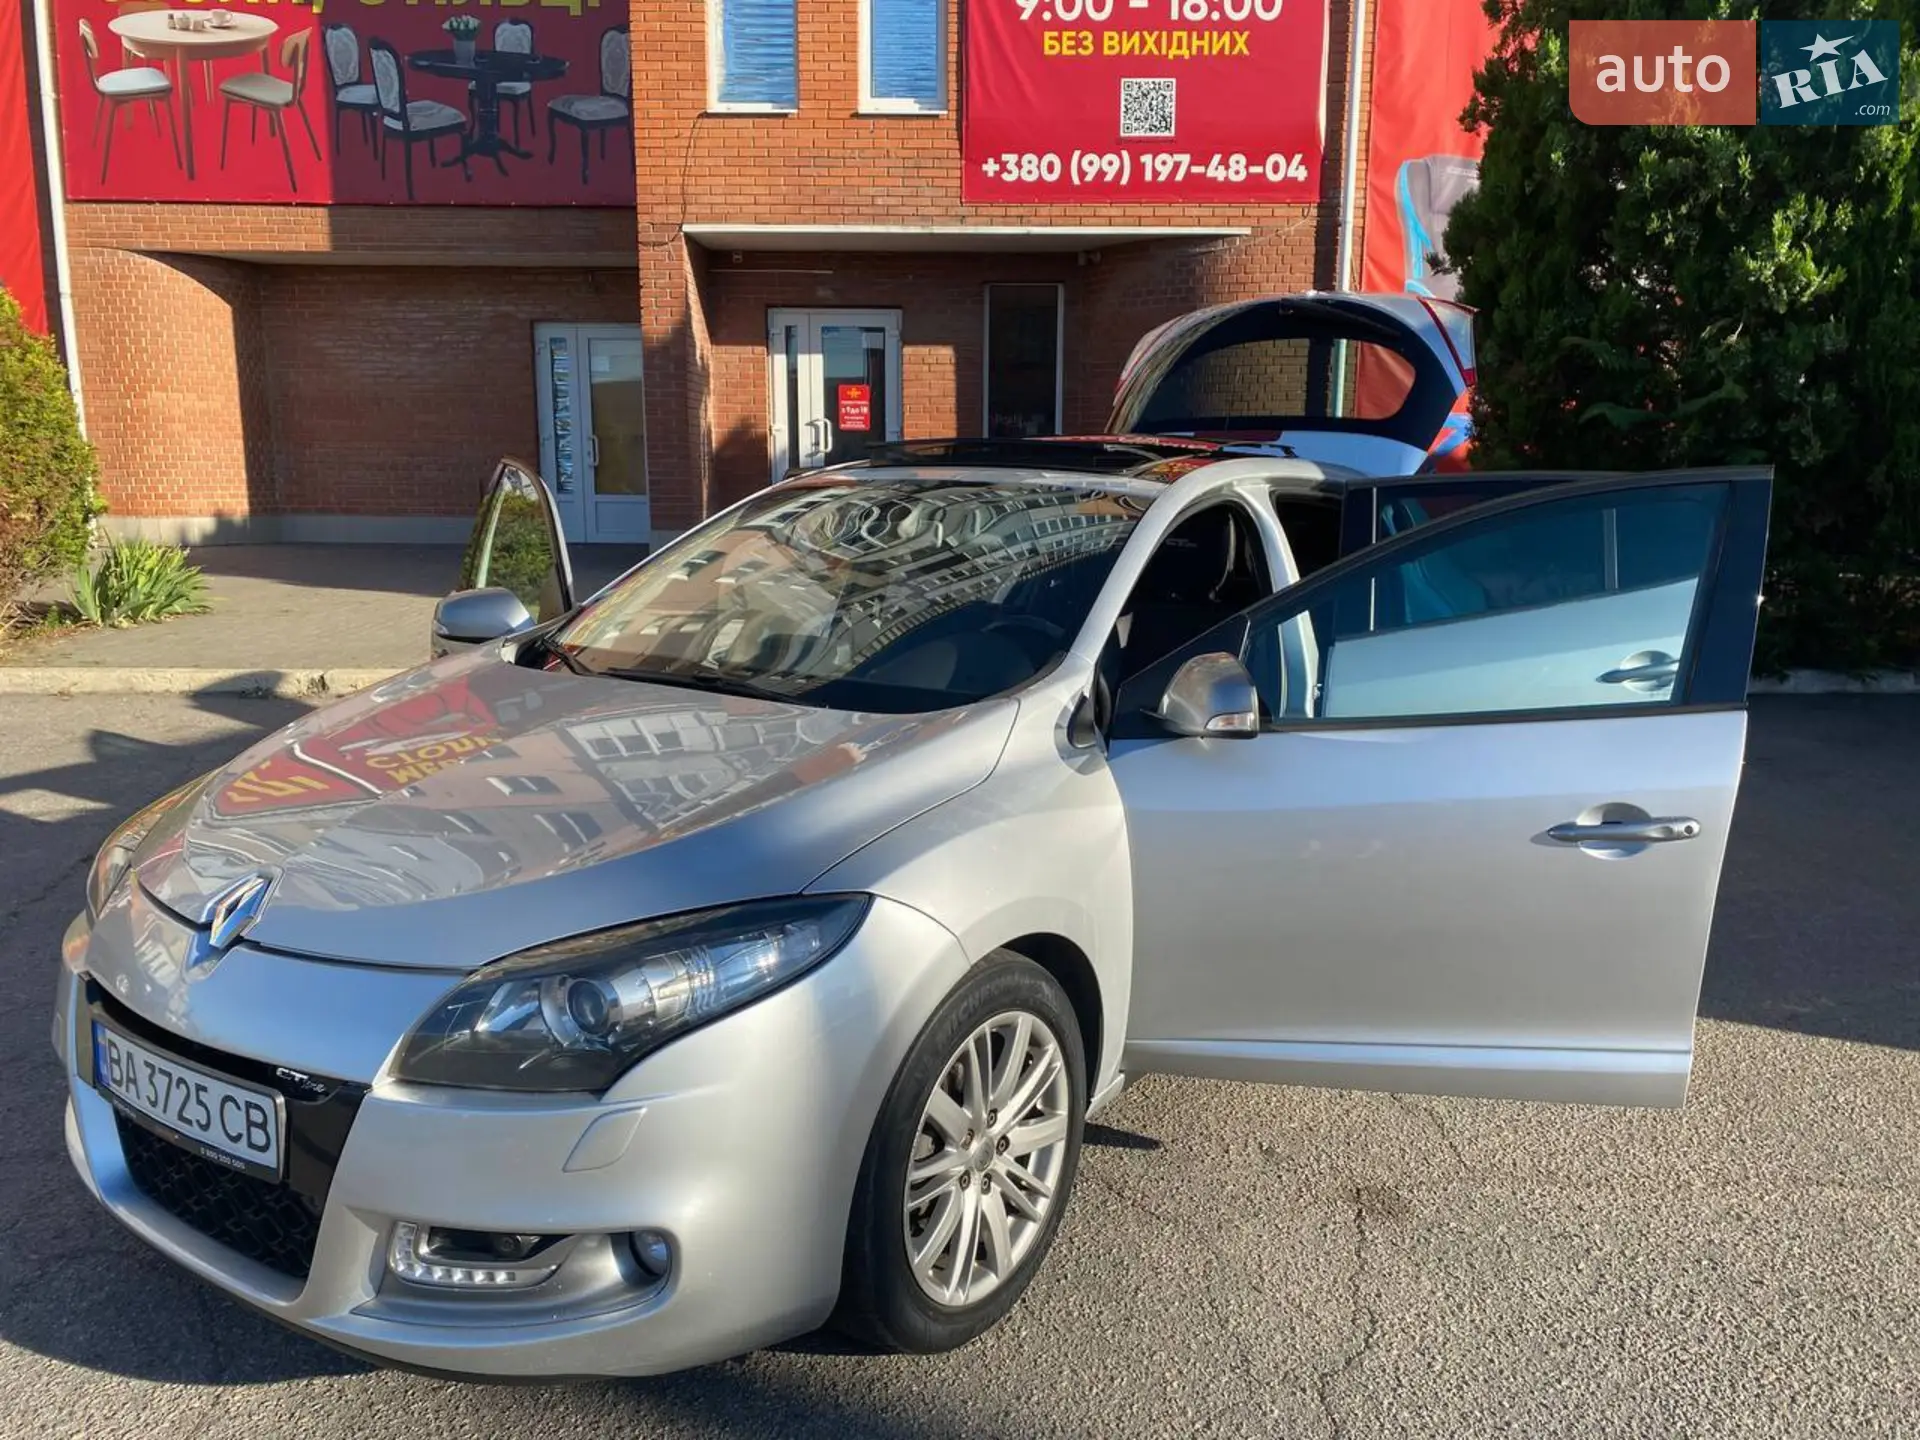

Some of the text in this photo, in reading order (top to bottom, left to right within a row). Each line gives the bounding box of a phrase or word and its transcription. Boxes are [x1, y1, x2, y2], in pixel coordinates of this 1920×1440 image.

[1043, 31, 1251, 59] БЕЗ ВИХІДНИХ
[981, 150, 1309, 186] +380 (99) 197-48-04
[107, 1037, 271, 1153] BA 3725 CB
